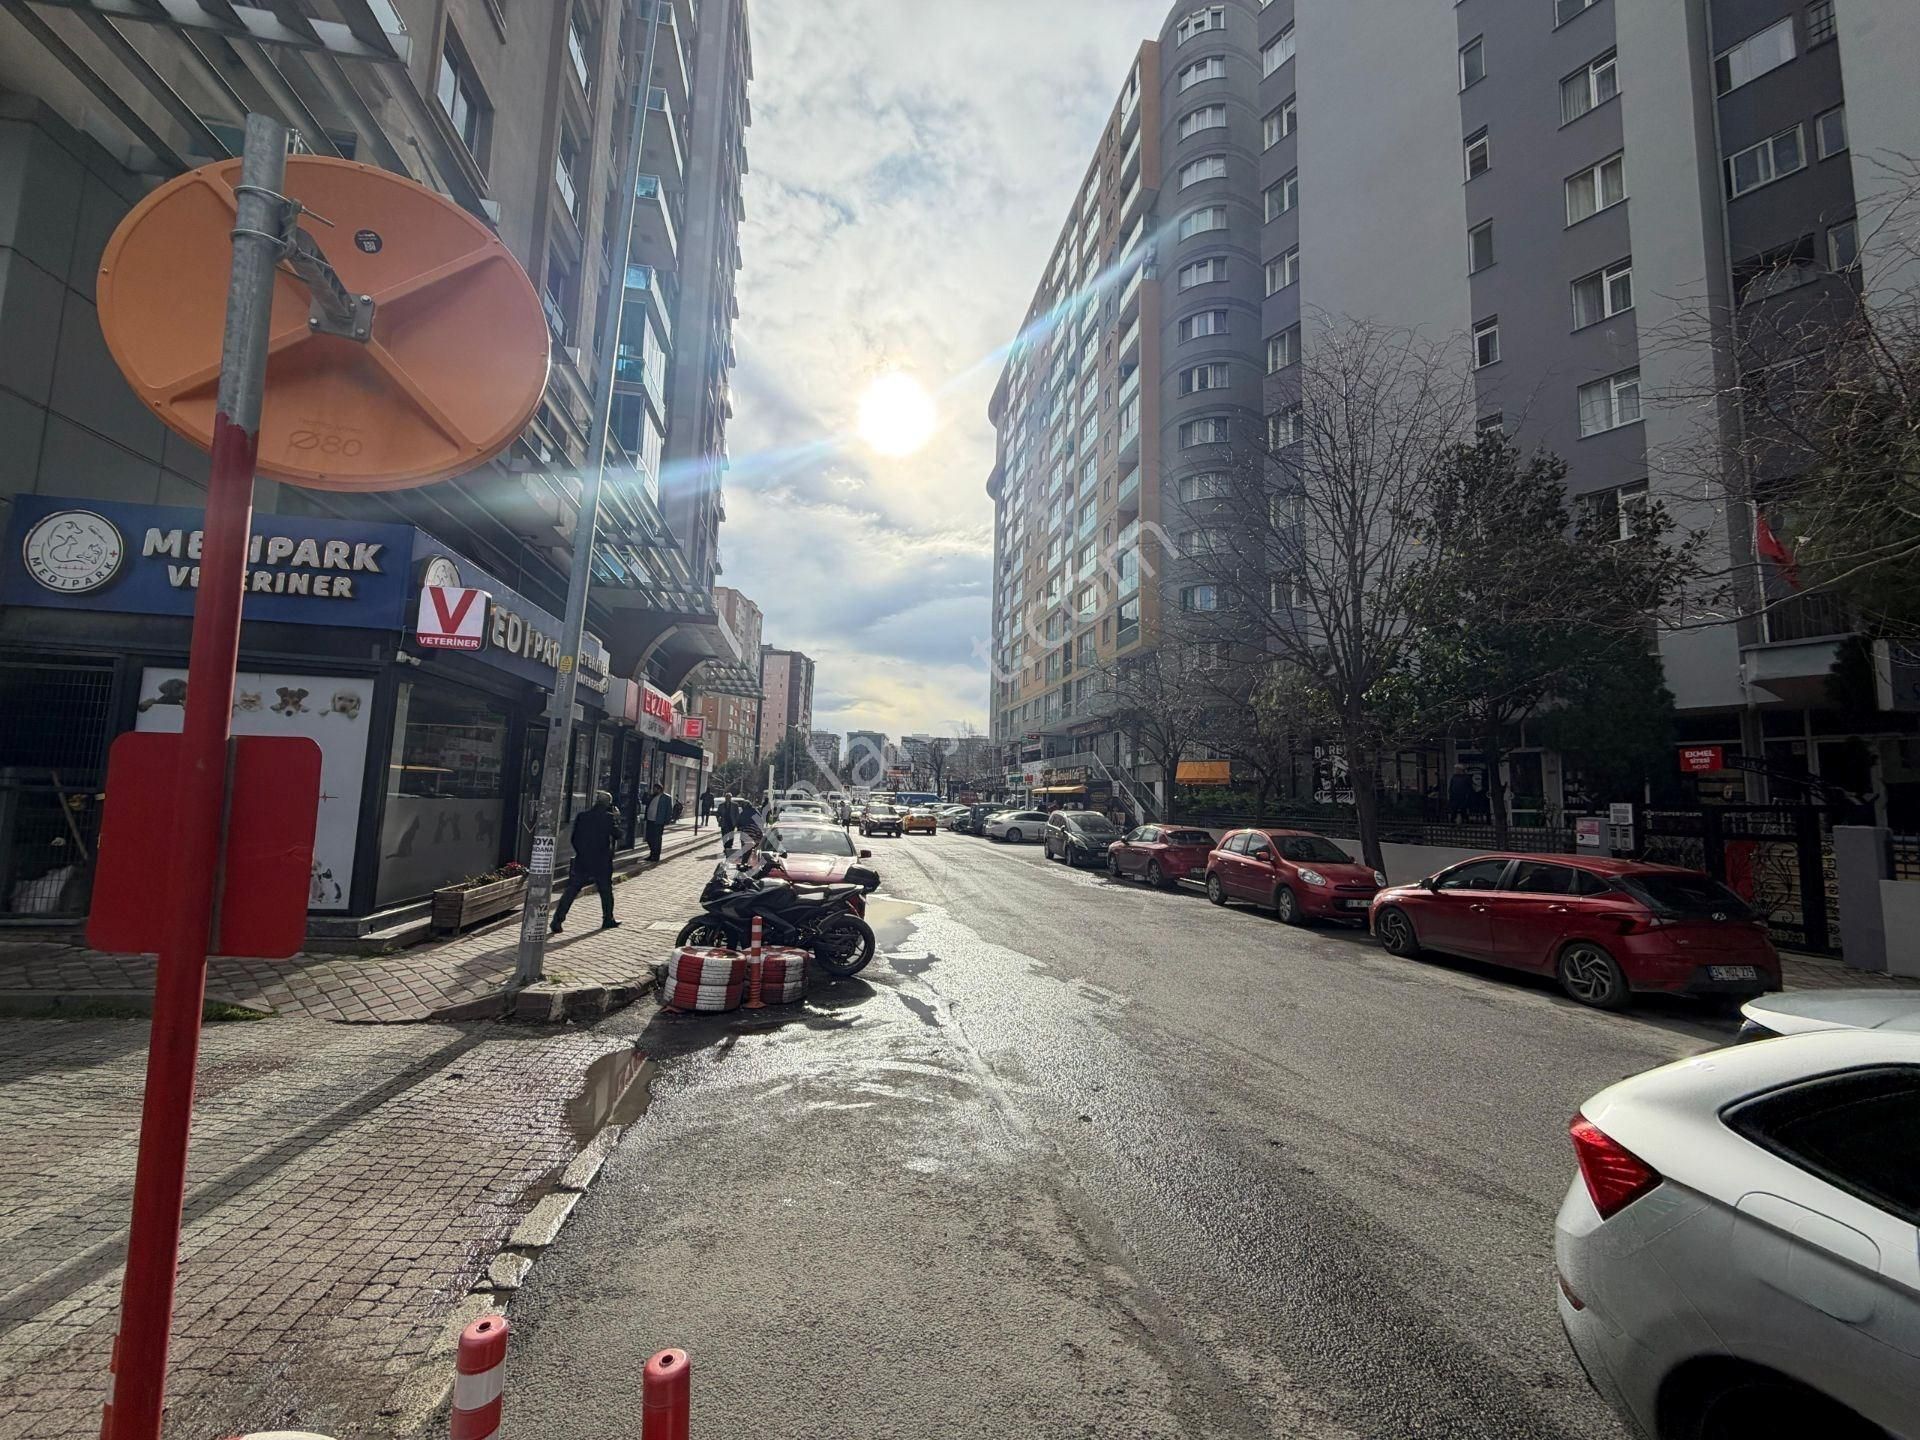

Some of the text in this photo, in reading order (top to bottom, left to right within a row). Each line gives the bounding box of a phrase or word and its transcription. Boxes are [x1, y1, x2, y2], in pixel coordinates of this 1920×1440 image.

[142, 527, 384, 573] MEIPARK
[168, 564, 354, 598] VERINER
[429, 586, 479, 634] V
[419, 636, 479, 648] VETERİNER
[491, 605, 562, 668] EDIPAR
